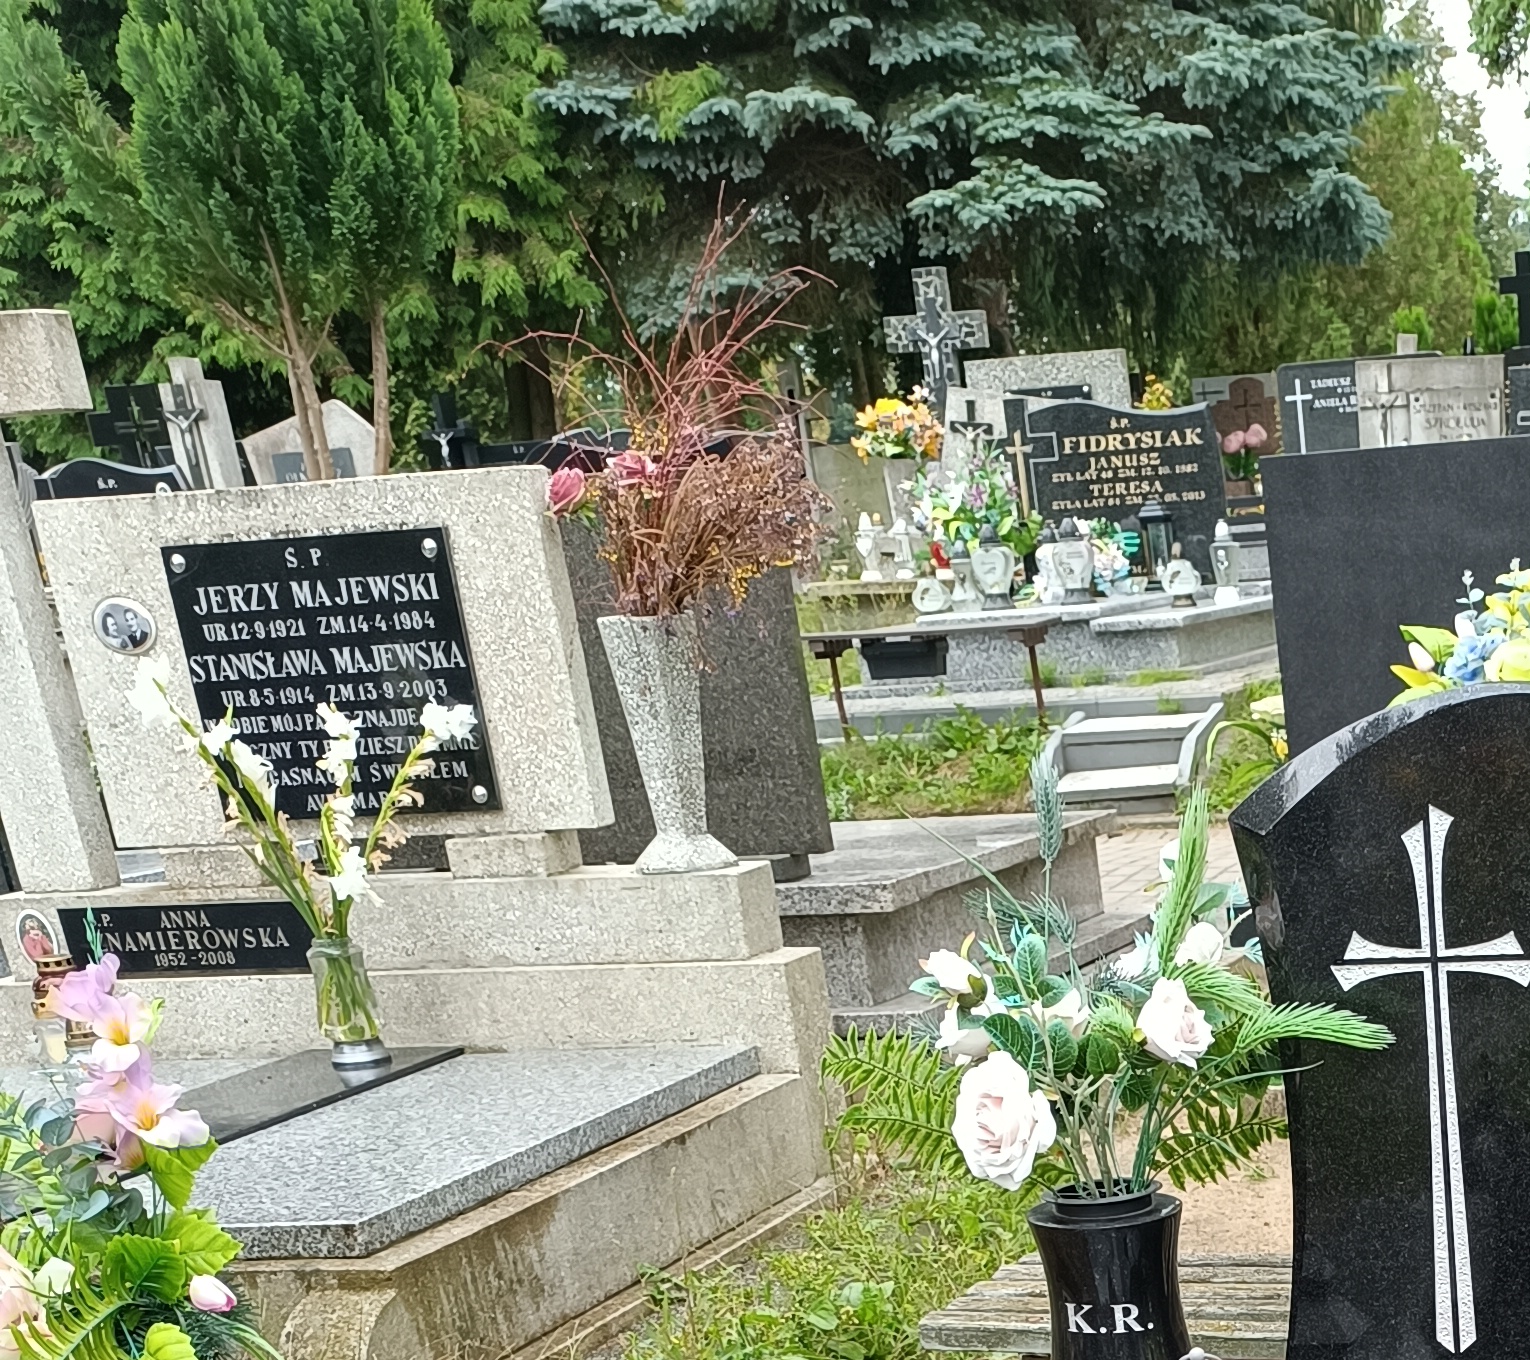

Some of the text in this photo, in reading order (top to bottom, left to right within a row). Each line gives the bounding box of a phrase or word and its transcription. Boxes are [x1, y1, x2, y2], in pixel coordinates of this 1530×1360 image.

[1062, 427, 1204, 454] FIDRYSIAK
[1089, 452, 1161, 471] JANUSZ
[1089, 480, 1163, 497] TERESA
[193, 572, 440, 615] JERZY MAJEWSKI
[189, 640, 466, 683] STANISŁAWA MAJEWSKA
[160, 910, 211, 930] ANNA
[1064, 1302, 1154, 1335] K.R.
